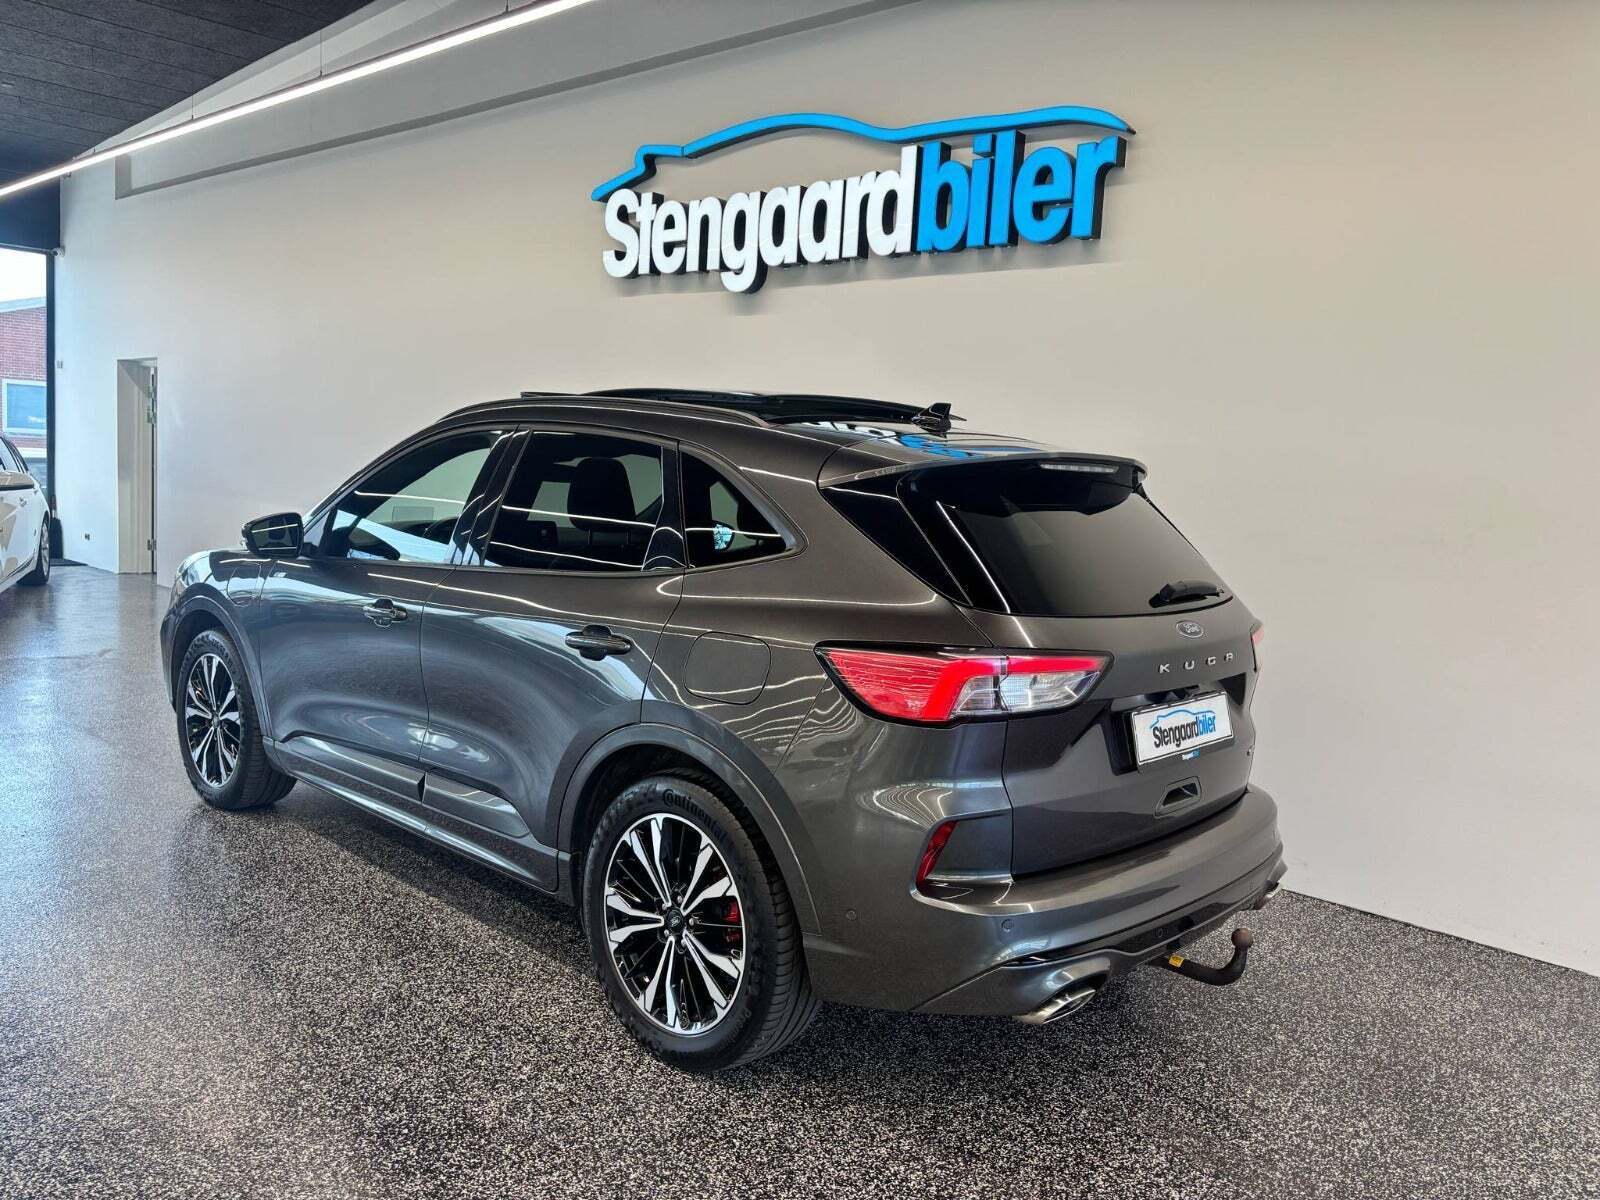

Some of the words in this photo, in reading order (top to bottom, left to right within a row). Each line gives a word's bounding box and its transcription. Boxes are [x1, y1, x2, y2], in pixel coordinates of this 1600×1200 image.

[602, 128, 1120, 292] Stengaardbiler
[1159, 652, 1234, 674] KUGA
[1152, 714, 1217, 748] Stengaardbiler
[662, 788, 728, 842] Continental
